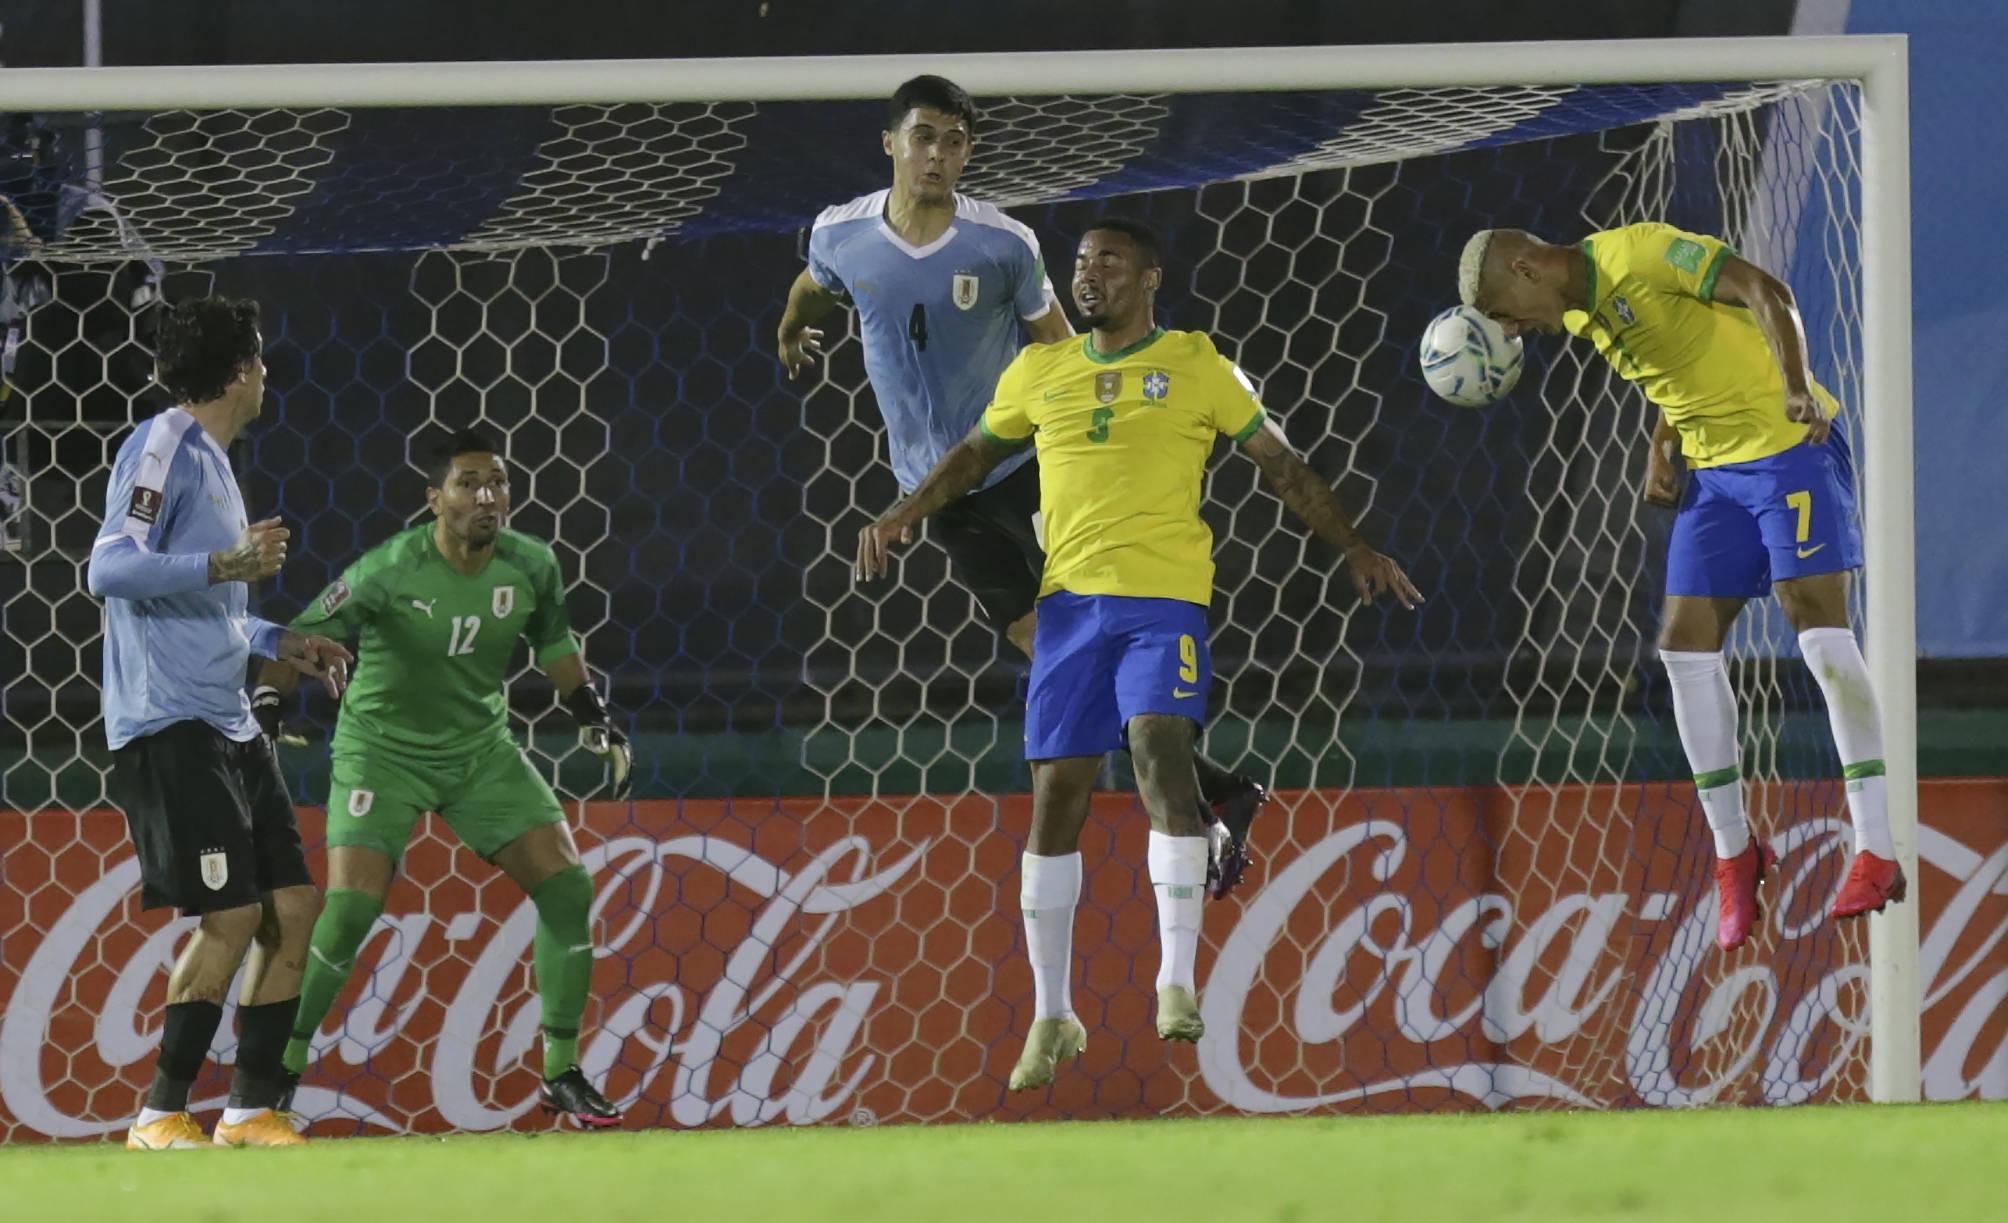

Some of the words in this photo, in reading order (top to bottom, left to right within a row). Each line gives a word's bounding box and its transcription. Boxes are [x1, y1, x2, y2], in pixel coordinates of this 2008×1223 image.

[908, 303, 928, 352] 4
[1785, 490, 1811, 543] 7
[448, 615, 481, 657] 12
[1179, 633, 1198, 684] 9
